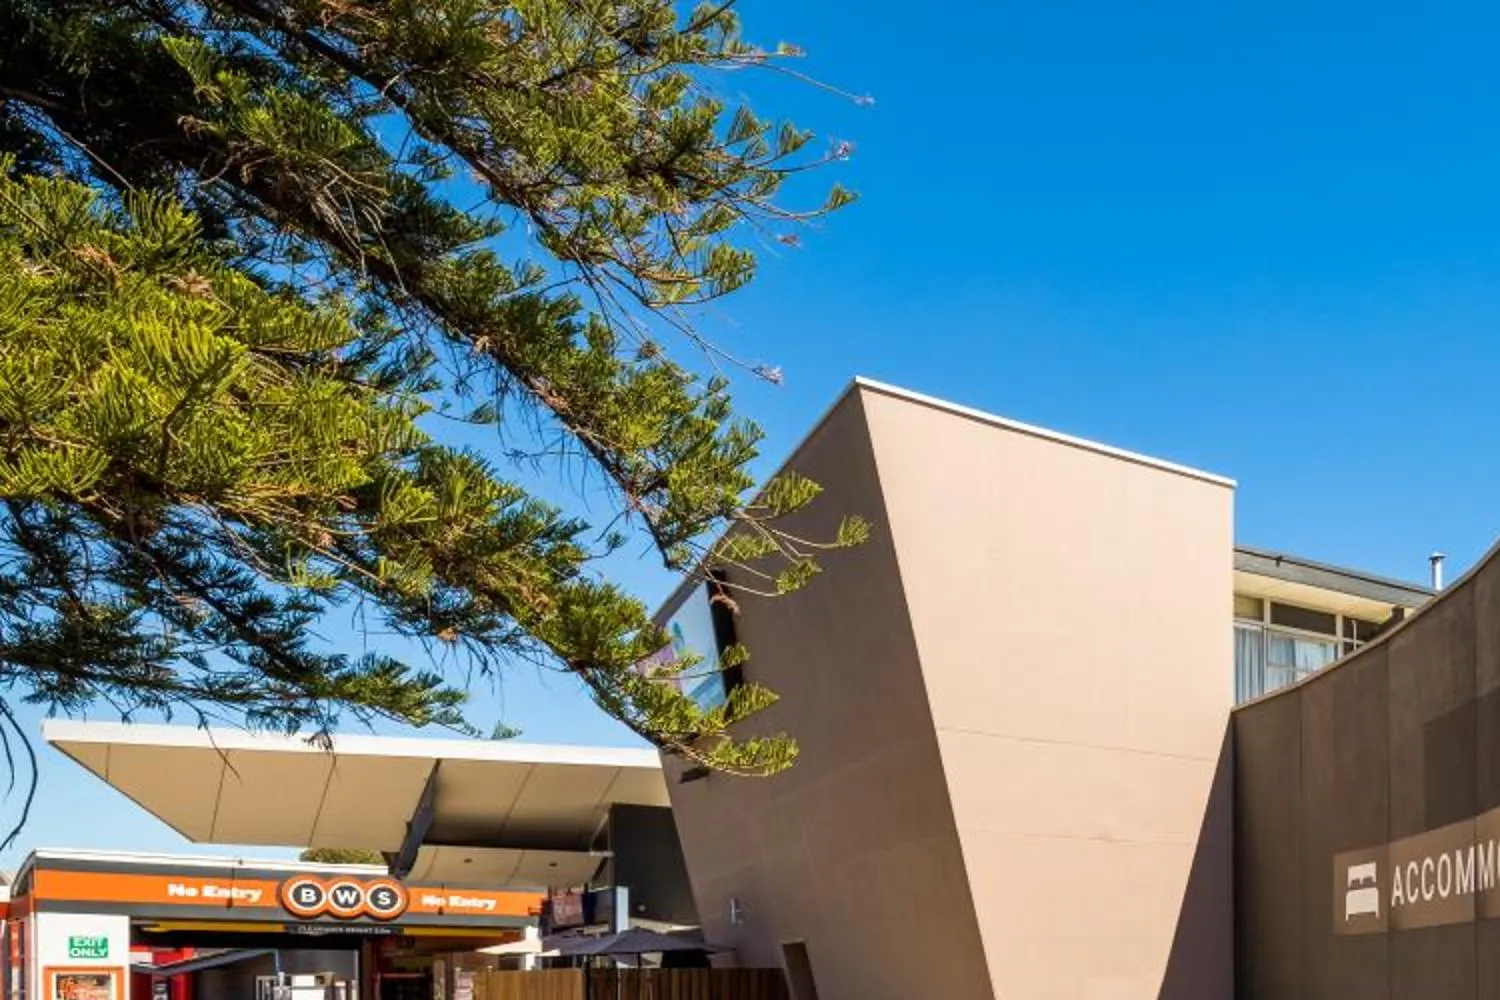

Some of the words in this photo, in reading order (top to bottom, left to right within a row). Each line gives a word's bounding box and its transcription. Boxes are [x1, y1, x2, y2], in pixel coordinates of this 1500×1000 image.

[167, 883, 198, 897] No
[202, 885, 263, 903] Entry
[300, 887, 392, 906] BWS
[73, 937, 104, 947] EXIT
[70, 947, 107, 958] ONLY
